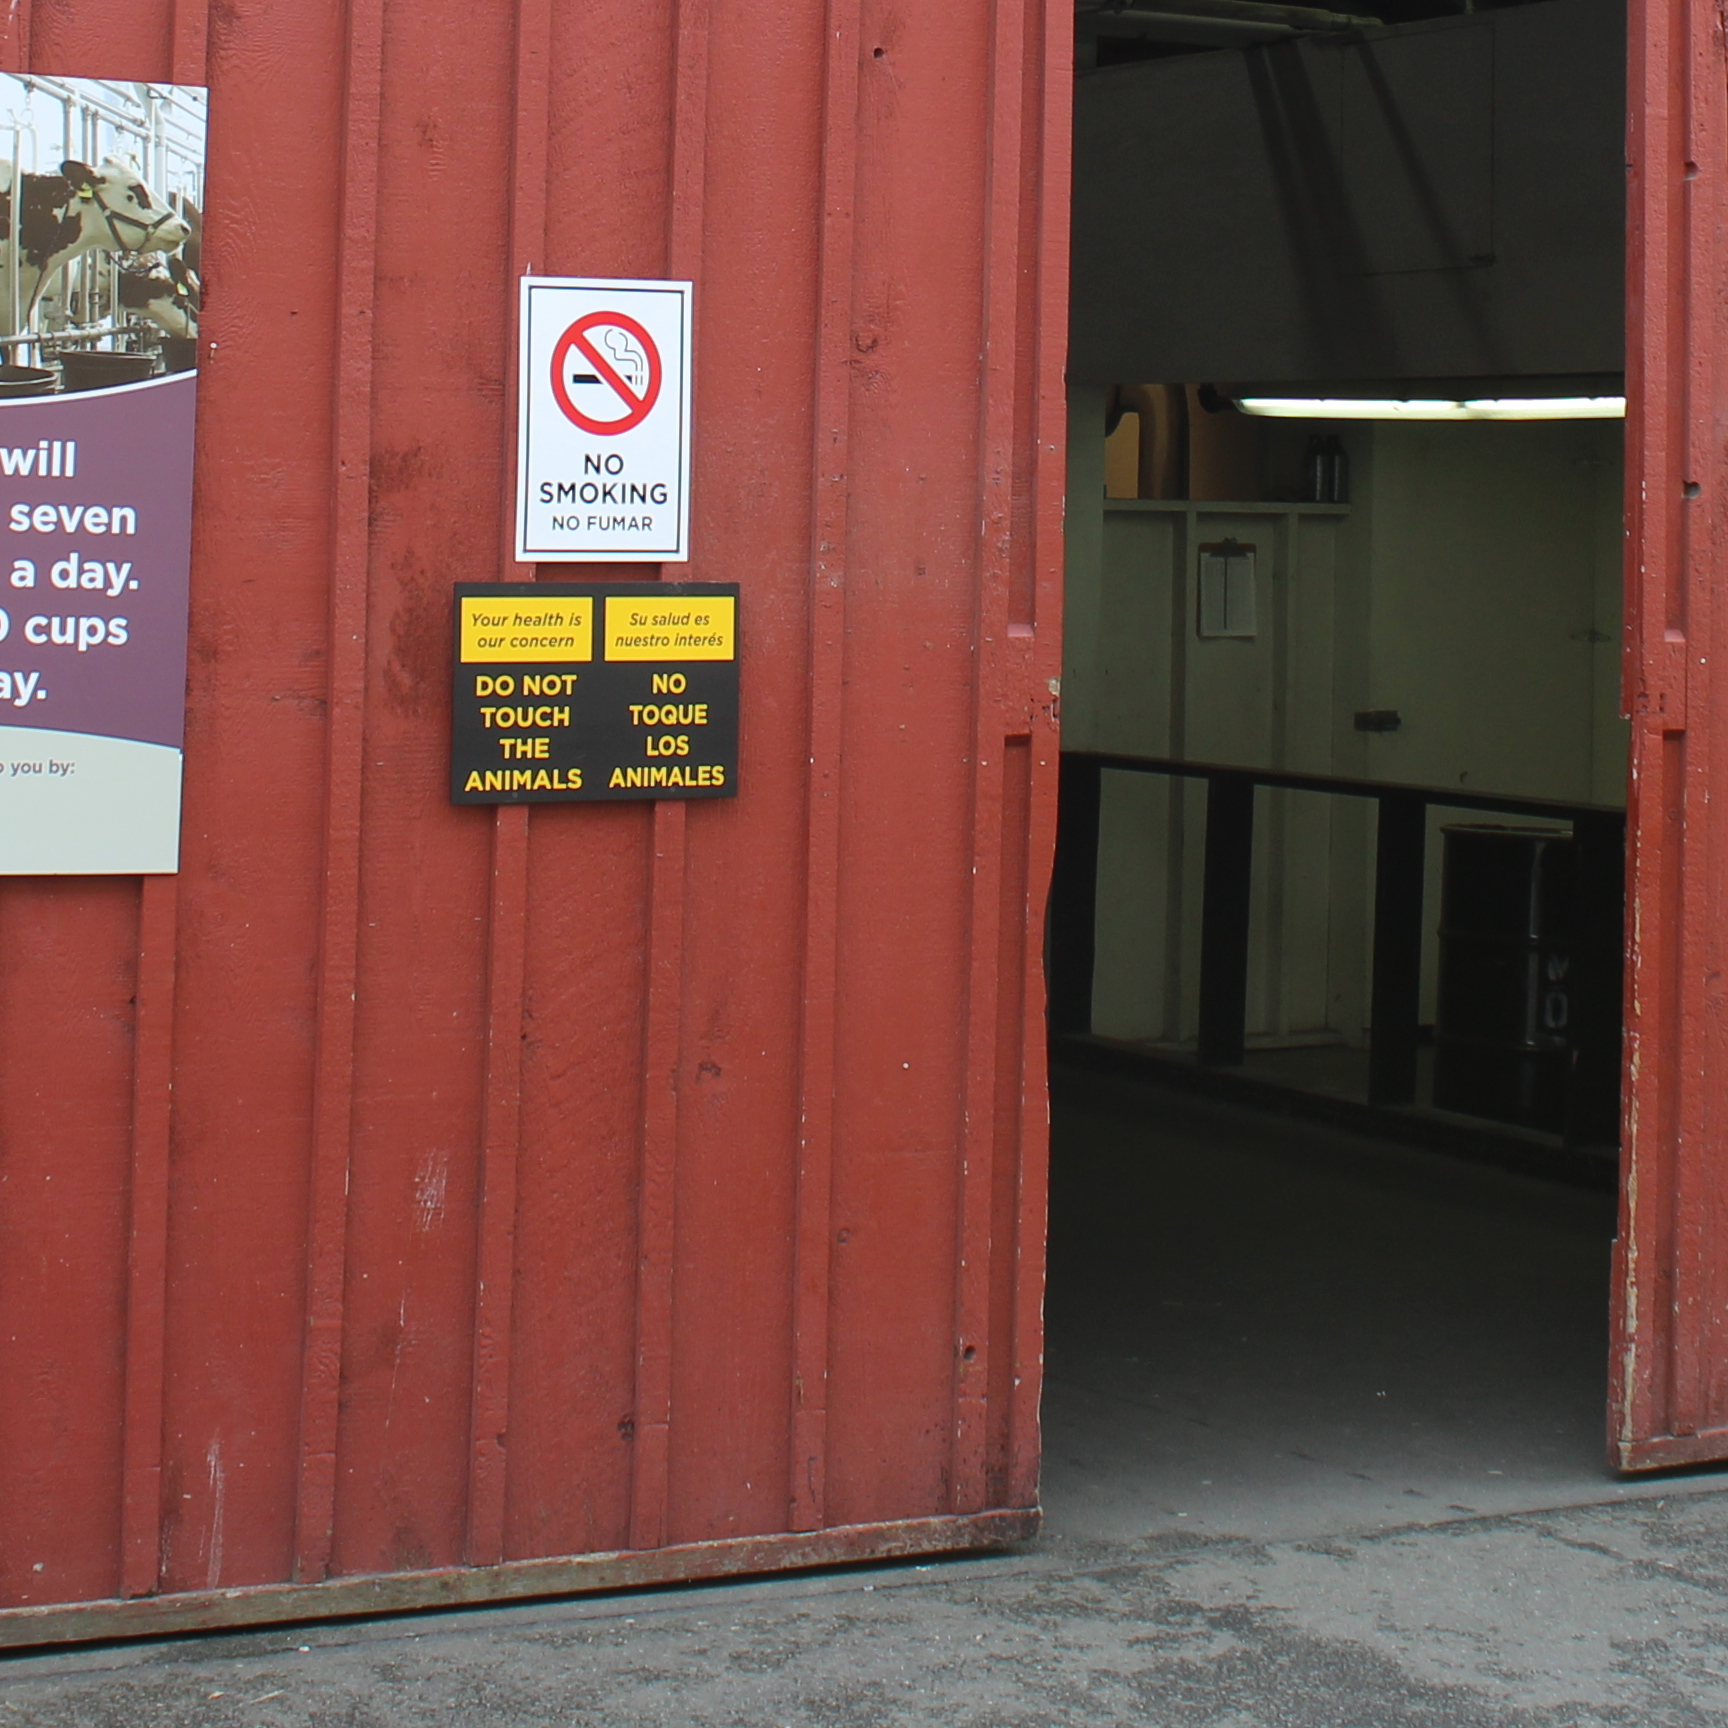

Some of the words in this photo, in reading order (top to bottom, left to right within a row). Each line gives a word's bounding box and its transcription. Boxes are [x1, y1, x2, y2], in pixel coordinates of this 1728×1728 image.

[0, 441, 75, 477] will
[585, 454, 623, 475] NO
[540, 482, 667, 504] SMOKING
[10, 504, 135, 534] seven
[553, 516, 580, 530] NO
[587, 516, 652, 531] FUMAR
[11, 560, 34, 587] a
[51, 553, 138, 596] day.
[472, 613, 509, 626] Your
[513, 613, 563, 626] health
[569, 612, 582, 626] is
[630, 613, 647, 626] Su
[652, 612, 691, 626] salud
[695, 615, 710, 625] es
[25, 616, 127, 651] cups
[478, 637, 505, 648] our
[510, 637, 574, 648] concern
[615, 634, 670, 647] nuestro
[674, 632, 723, 646] interés
[476, 676, 514, 696] DO
[523, 675, 577, 695] NOT
[653, 674, 686, 694] NO
[481, 707, 569, 728] TOUCH
[629, 705, 707, 725] TOQUE
[500, 738, 549, 759] THE
[647, 736, 689, 756] LOS
[11, 763, 42, 777] you
[49, 759, 75, 777] by:
[609, 766, 724, 788] ANIMALES
[465, 769, 582, 791] ANIMALS
